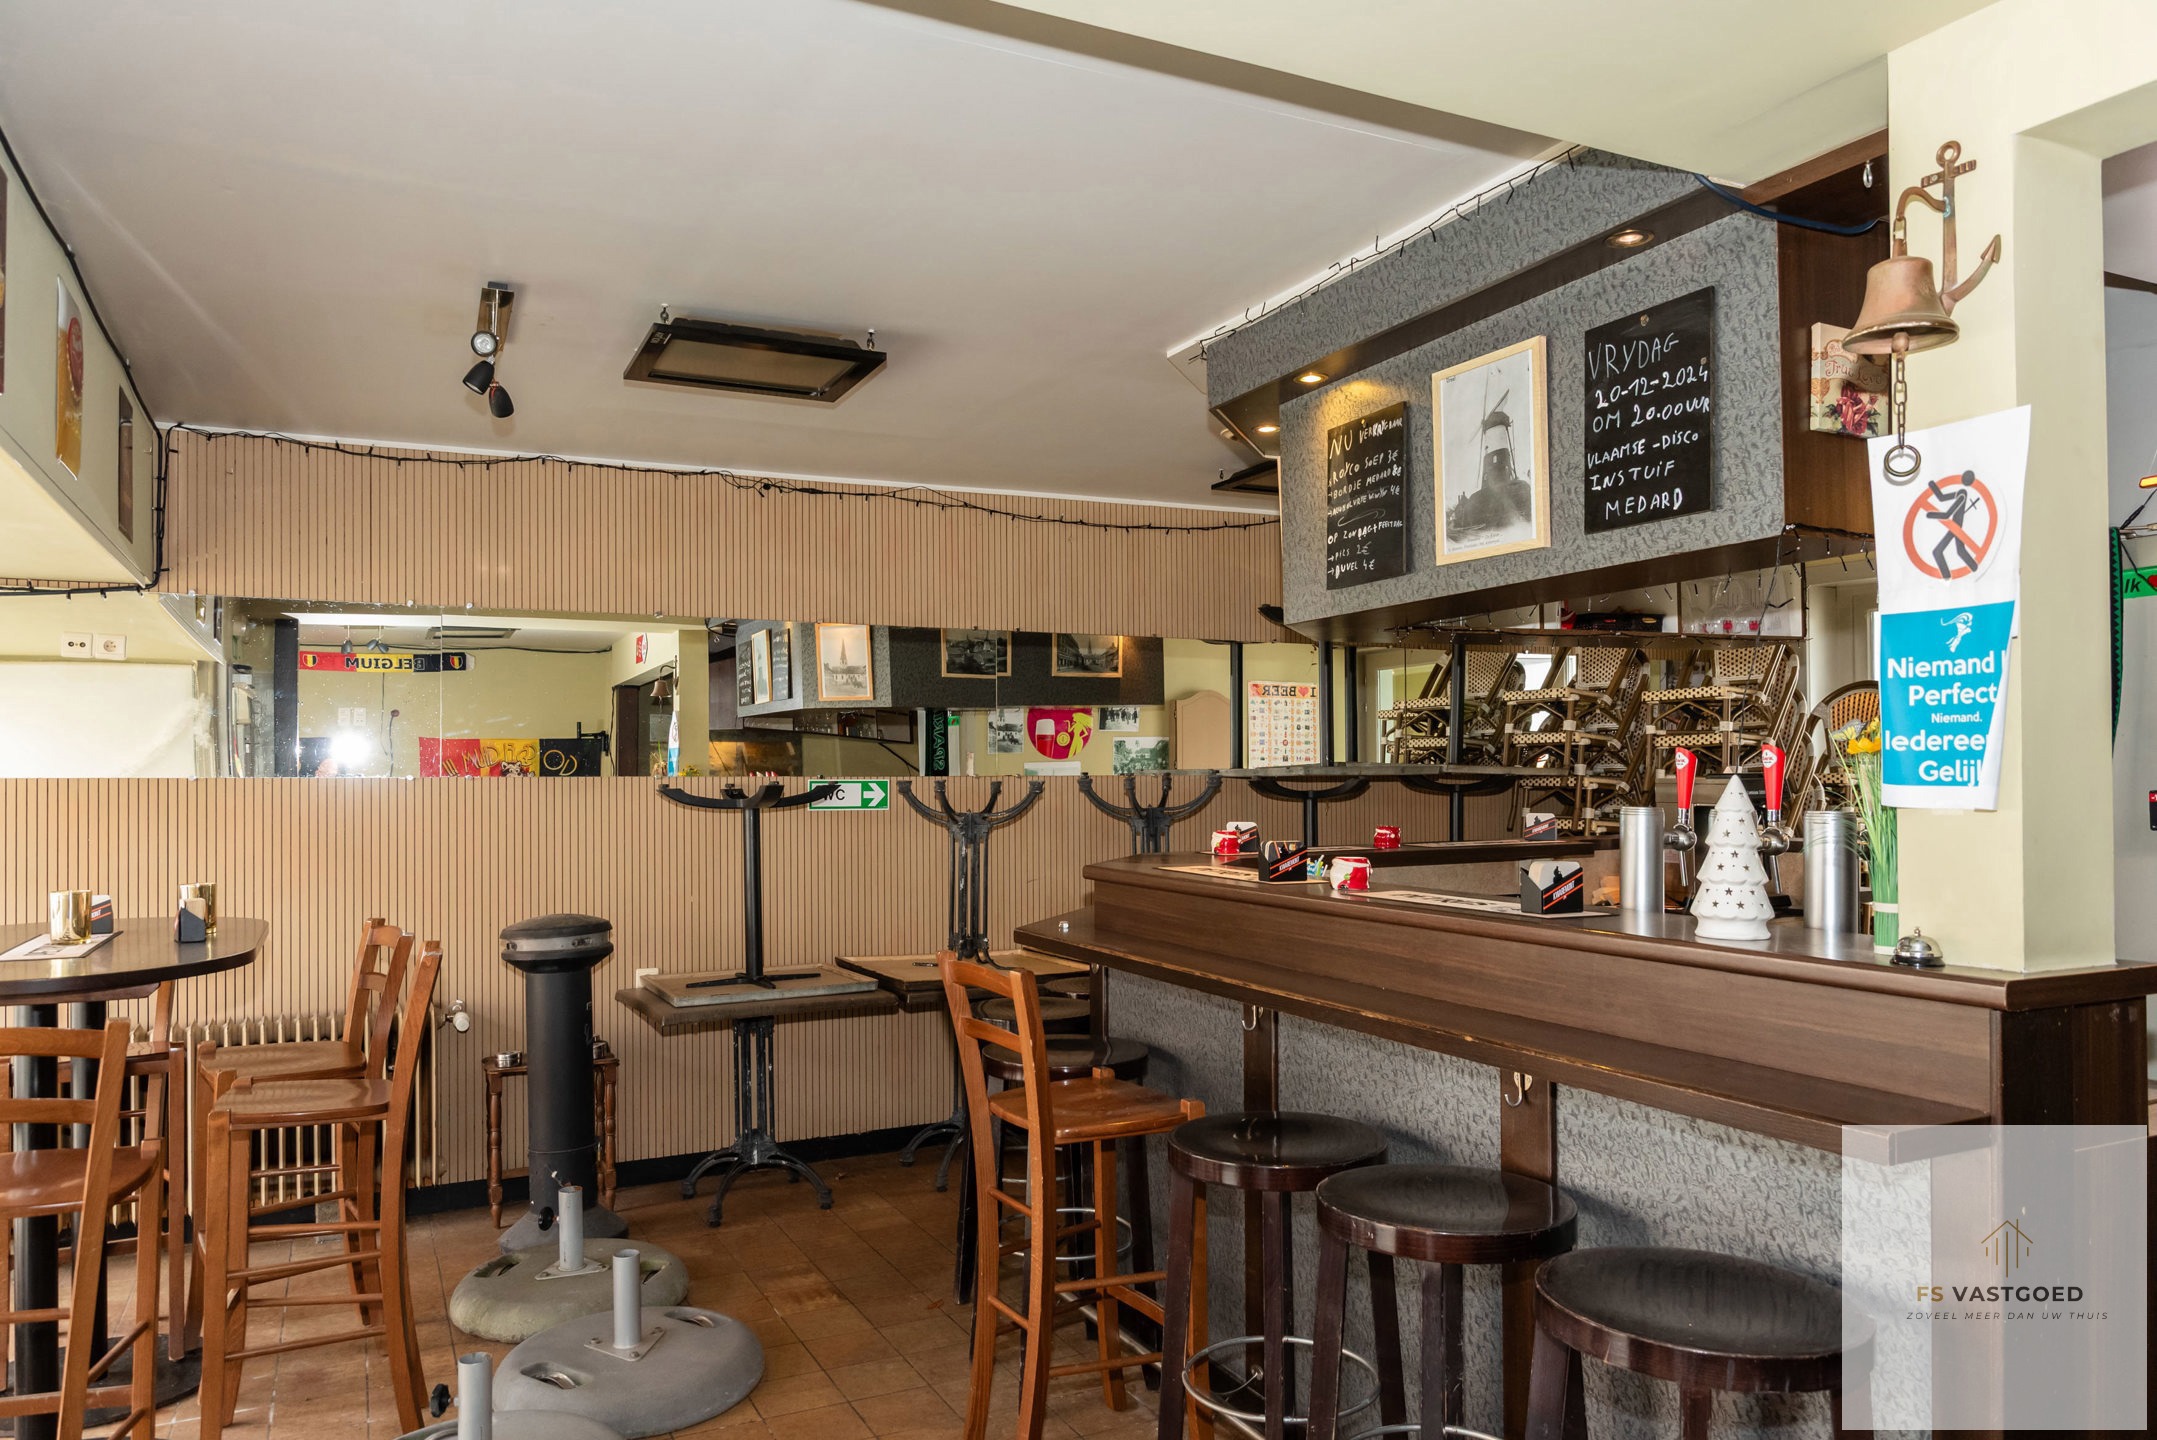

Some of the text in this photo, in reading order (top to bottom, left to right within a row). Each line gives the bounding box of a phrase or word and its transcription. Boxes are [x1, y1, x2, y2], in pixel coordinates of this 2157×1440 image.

[1588, 332, 1679, 380] VRYDAG
[1595, 365, 1708, 409] 20-12-2024
[1592, 409, 1620, 433] OM
[1329, 429, 1353, 460] NU
[1587, 438, 1646, 469] VLAAMSE
[1605, 487, 1683, 521] MEDARD
[1327, 532, 1339, 545] OP
[1335, 561, 1358, 579] DUVEL
[1887, 650, 1995, 679] Niemand
[1908, 682, 1998, 706] Perfect
[1931, 711, 1983, 723] Niemand.
